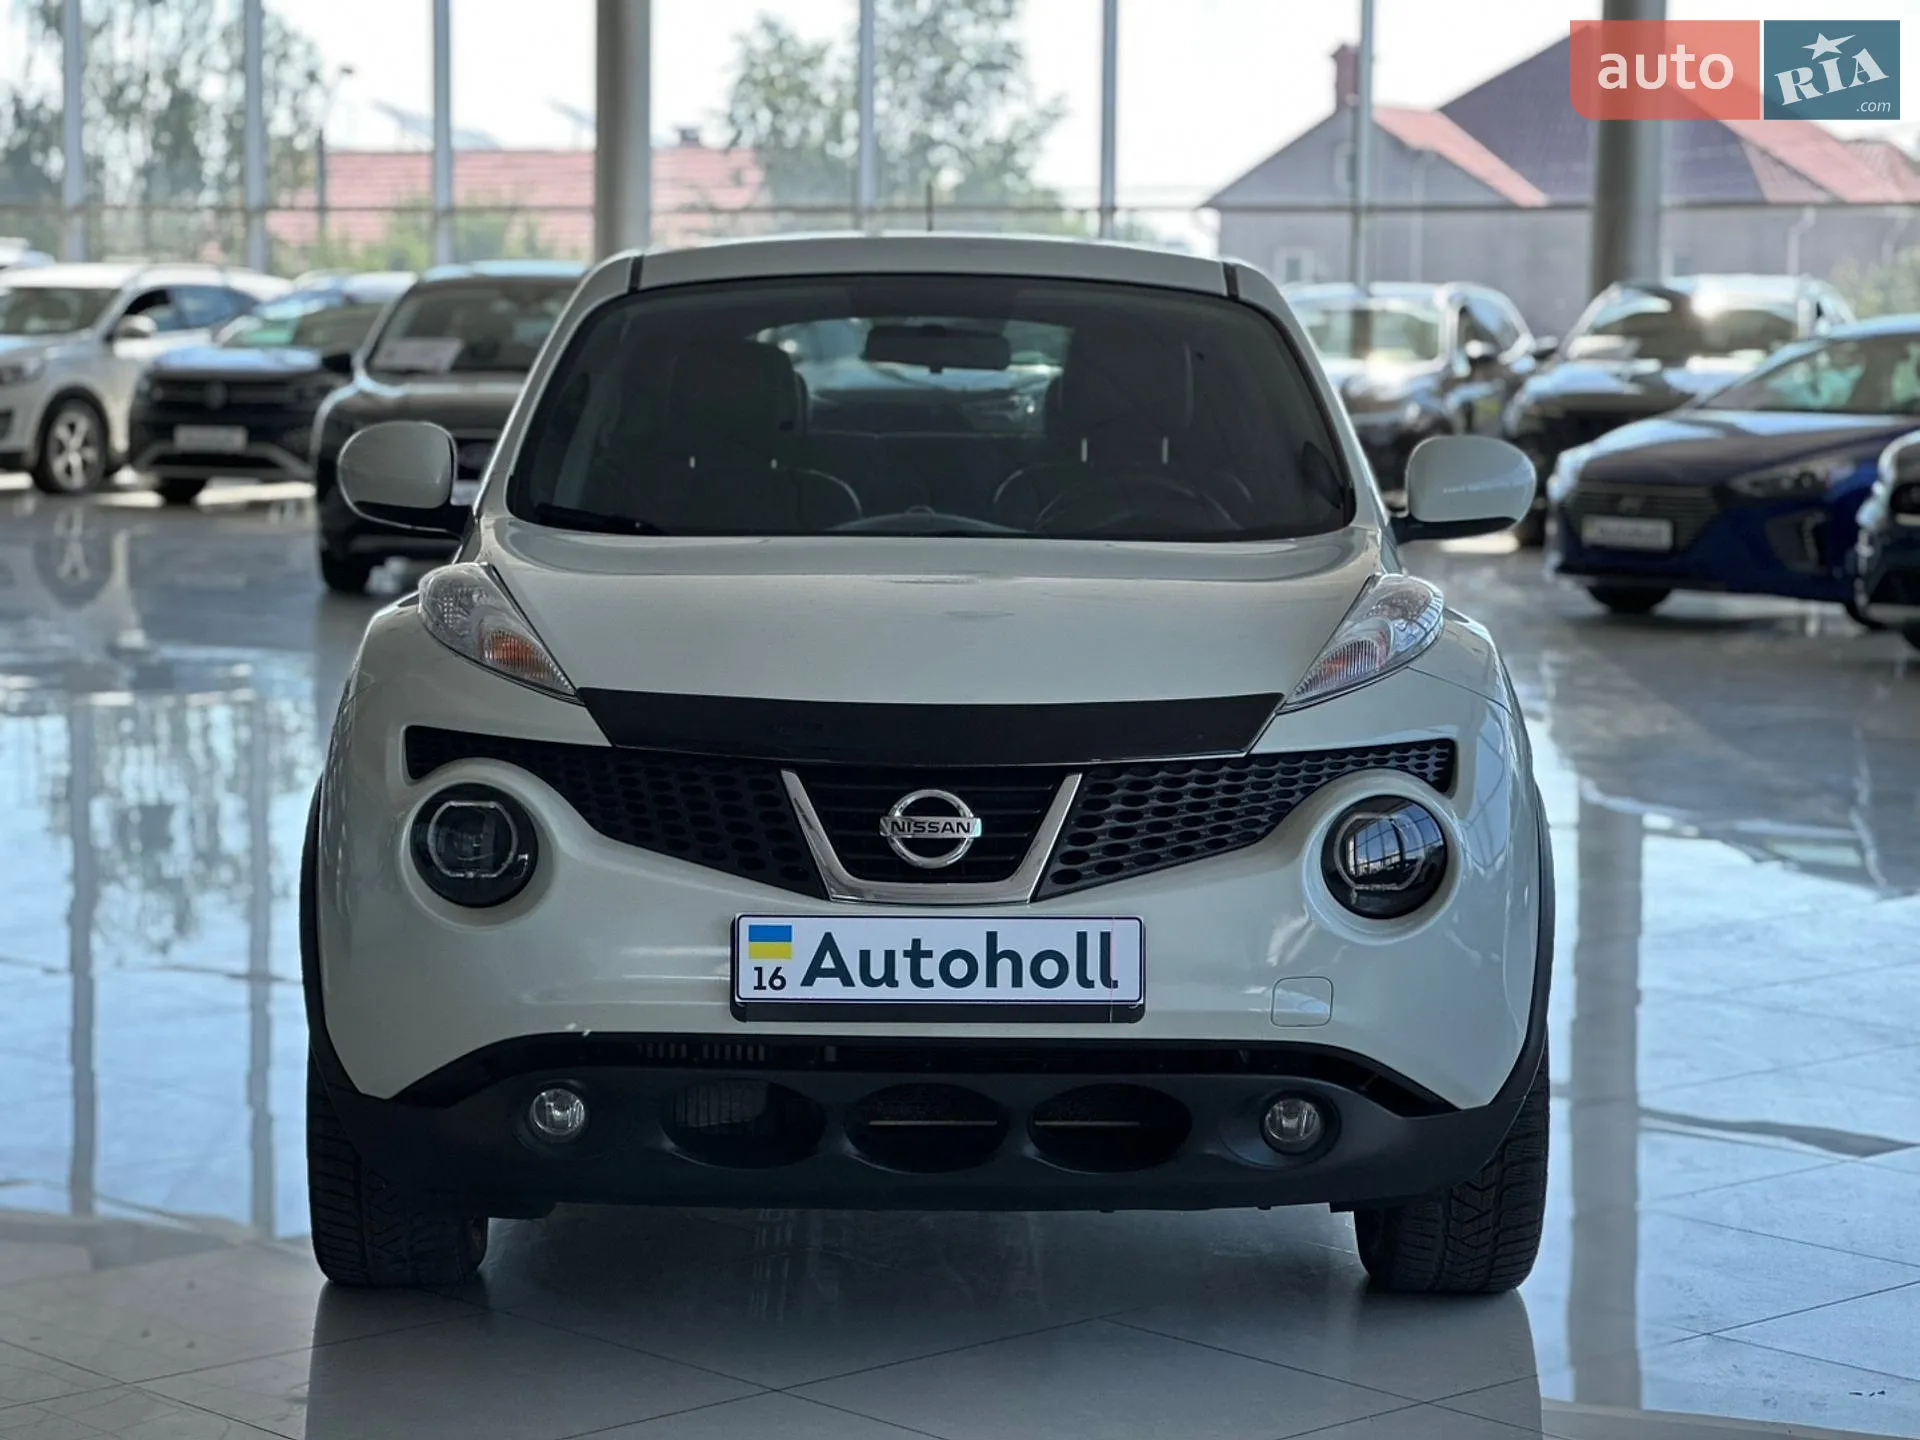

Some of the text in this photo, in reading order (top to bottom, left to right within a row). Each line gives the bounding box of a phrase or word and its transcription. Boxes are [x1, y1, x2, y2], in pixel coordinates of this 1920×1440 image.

[891, 821, 970, 834] NISSAN
[800, 931, 1119, 990] Autoholl
[753, 966, 787, 991] 16
